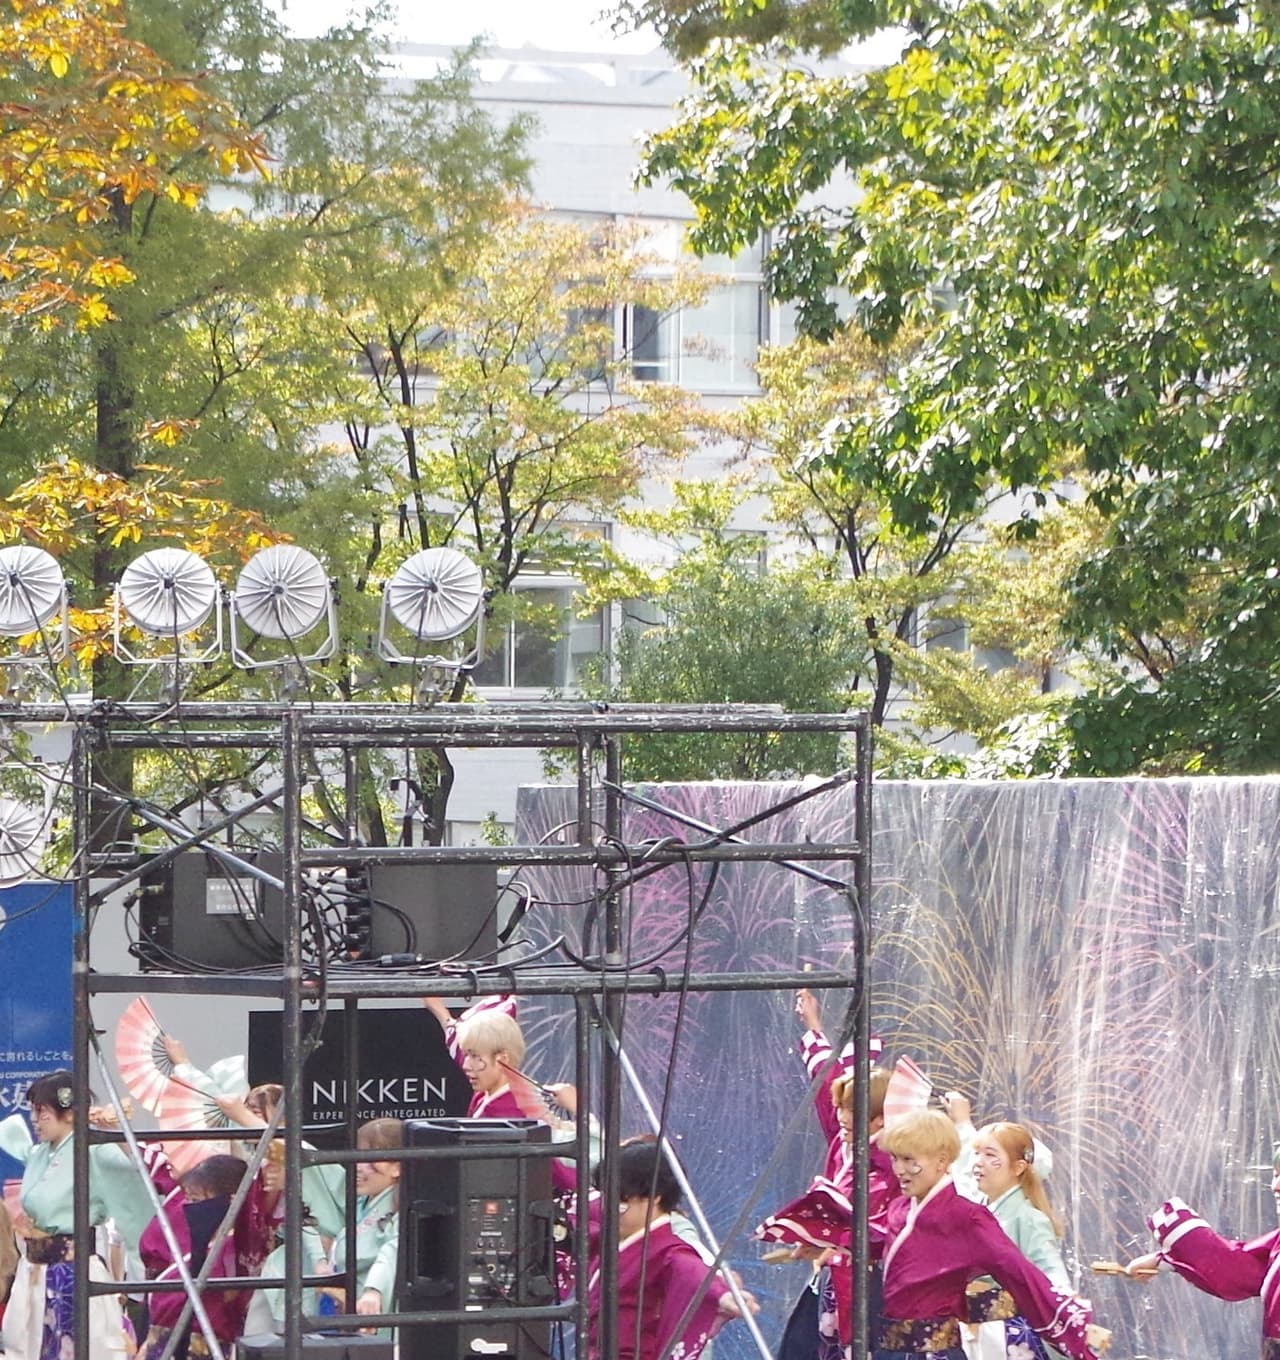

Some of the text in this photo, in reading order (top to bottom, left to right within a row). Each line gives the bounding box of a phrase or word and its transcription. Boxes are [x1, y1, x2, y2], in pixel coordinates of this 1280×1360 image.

[312, 1077, 447, 1105] NIKKEN
[313, 1108, 447, 1121] EXPERNCE INTEGRATED
